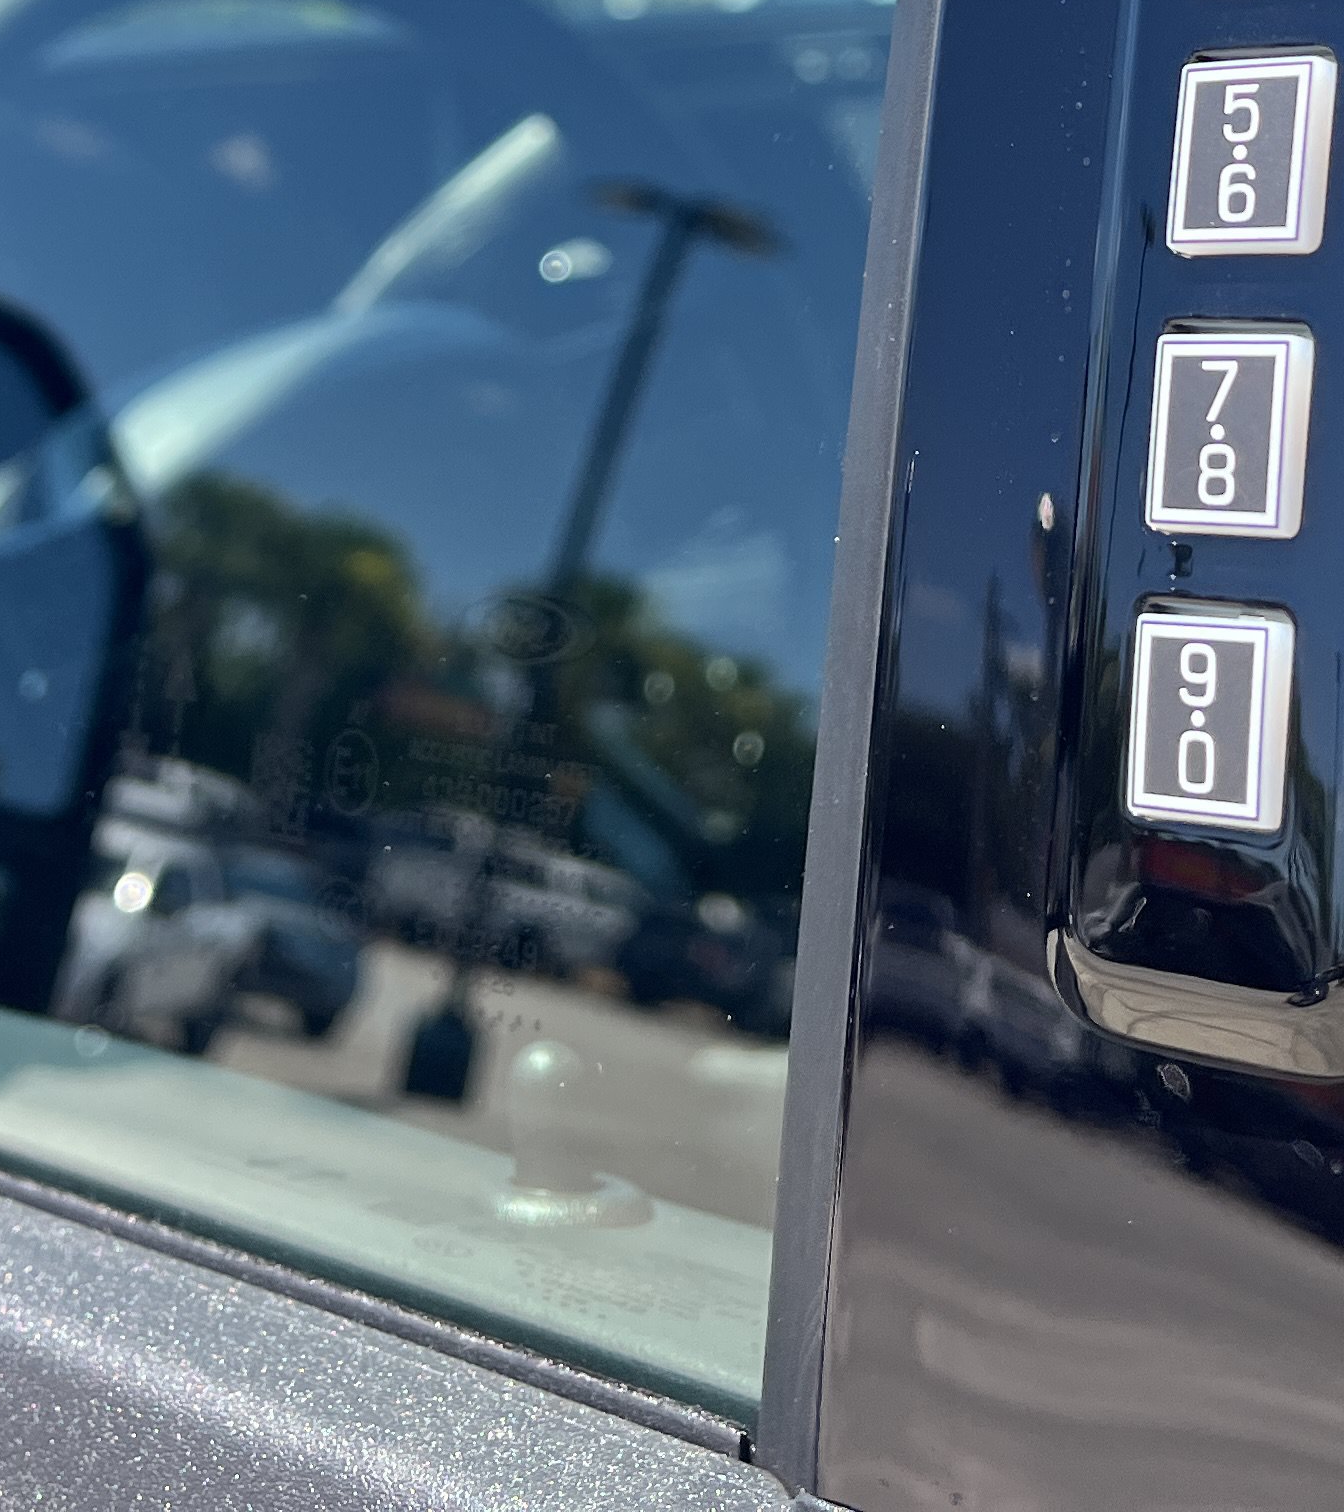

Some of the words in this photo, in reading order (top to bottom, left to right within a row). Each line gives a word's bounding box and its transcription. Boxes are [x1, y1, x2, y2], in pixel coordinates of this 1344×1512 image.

[1222, 83, 1261, 143] 5
[1217, 163, 1257, 224] 6
[1201, 359, 1239, 423] 7
[1197, 443, 1237, 507] 8
[1178, 642, 1218, 708] 9
[1177, 729, 1217, 795] 0
